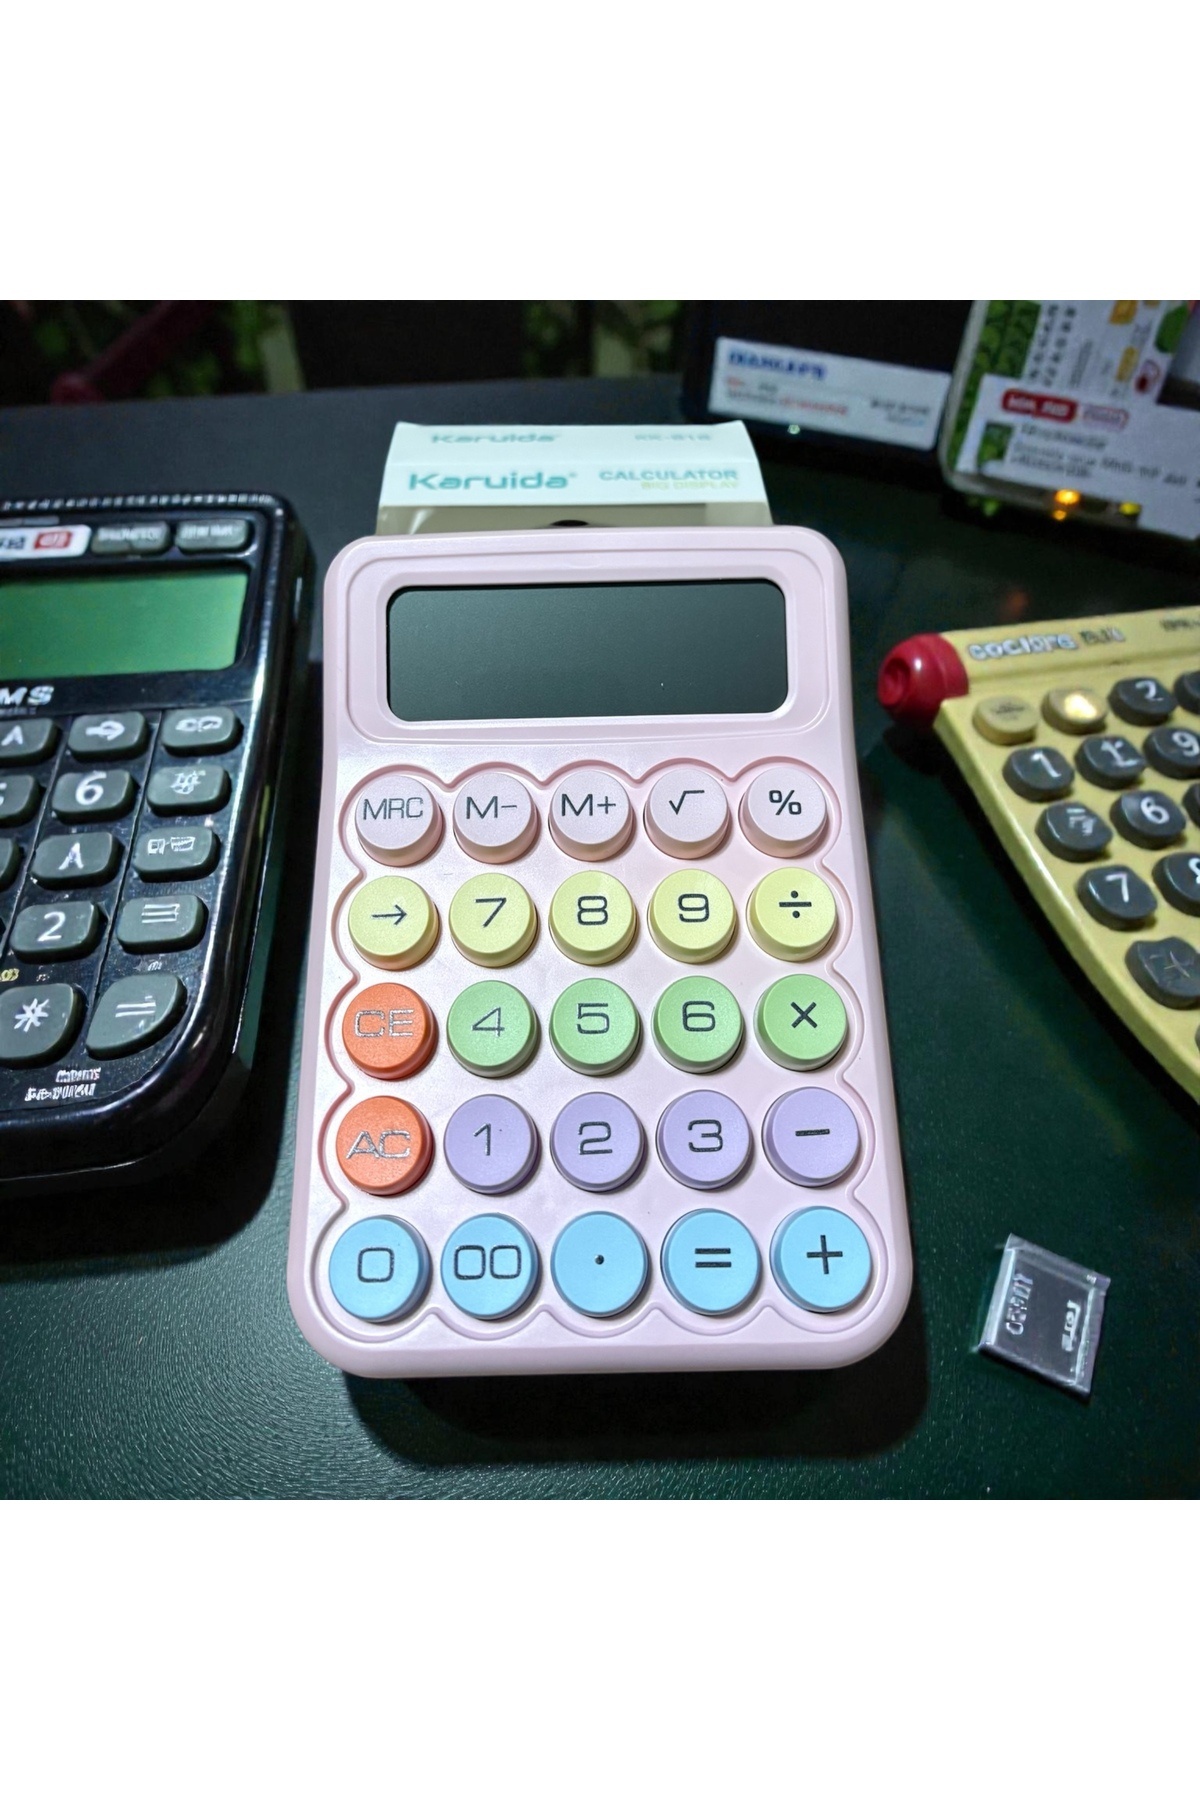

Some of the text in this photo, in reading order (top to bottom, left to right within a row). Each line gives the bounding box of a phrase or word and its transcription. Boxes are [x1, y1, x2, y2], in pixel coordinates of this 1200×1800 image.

[598, 470, 739, 481] CALCULATOR
[673, 480, 740, 490] DISPLAY
[75, 771, 108, 806] 6
[768, 788, 802, 816] %
[362, 797, 424, 821] MRC
[560, 793, 617, 817] M+
[1140, 797, 1170, 825] 6
[1105, 872, 1130, 902] 7
[475, 897, 507, 929] 7
[576, 894, 609, 926] 8
[677, 892, 710, 923] 9
[37, 911, 66, 942] 2
[354, 1007, 416, 1038] CE
[471, 1006, 505, 1037] 4
[576, 1002, 610, 1035] 5
[681, 1000, 716, 1033] 6
[345, 1129, 412, 1160] AC
[473, 1122, 492, 1157] 1
[577, 1120, 613, 1155] 2
[687, 1118, 724, 1153] 3
[356, 1246, 395, 1284] 0
[453, 1244, 523, 1281] 00
